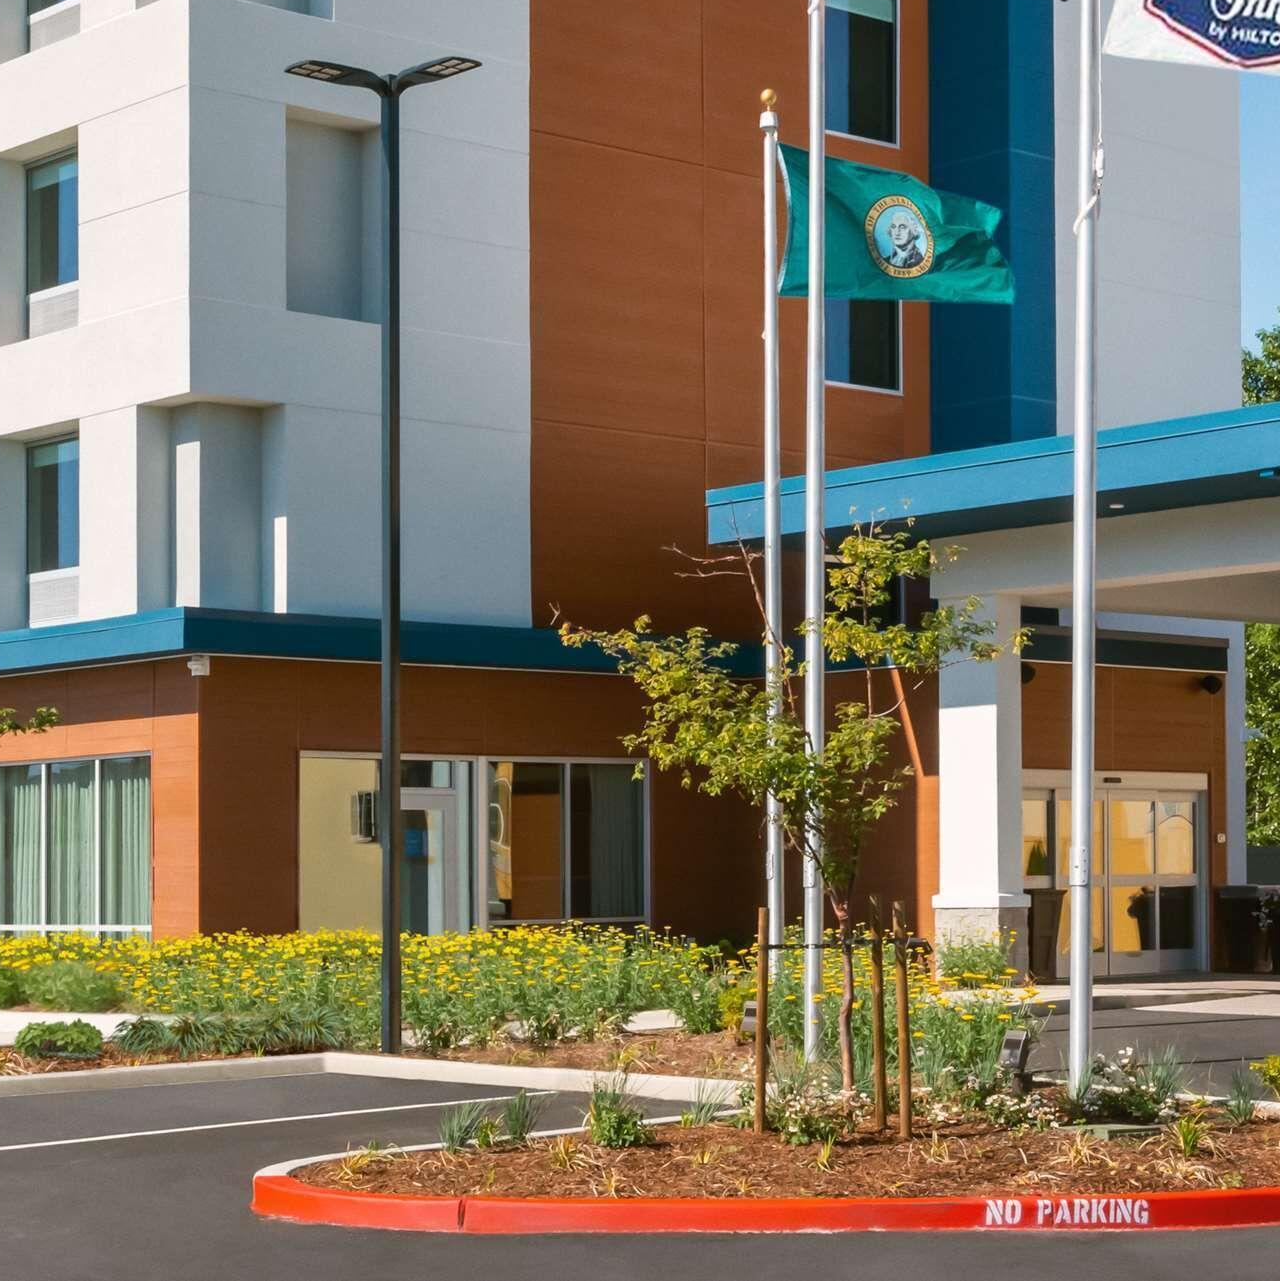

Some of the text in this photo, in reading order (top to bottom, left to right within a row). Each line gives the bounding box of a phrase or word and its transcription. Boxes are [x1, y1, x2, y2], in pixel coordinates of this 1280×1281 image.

[1208, 21, 1227, 41] by
[985, 1198, 1150, 1225] NO PARKING
